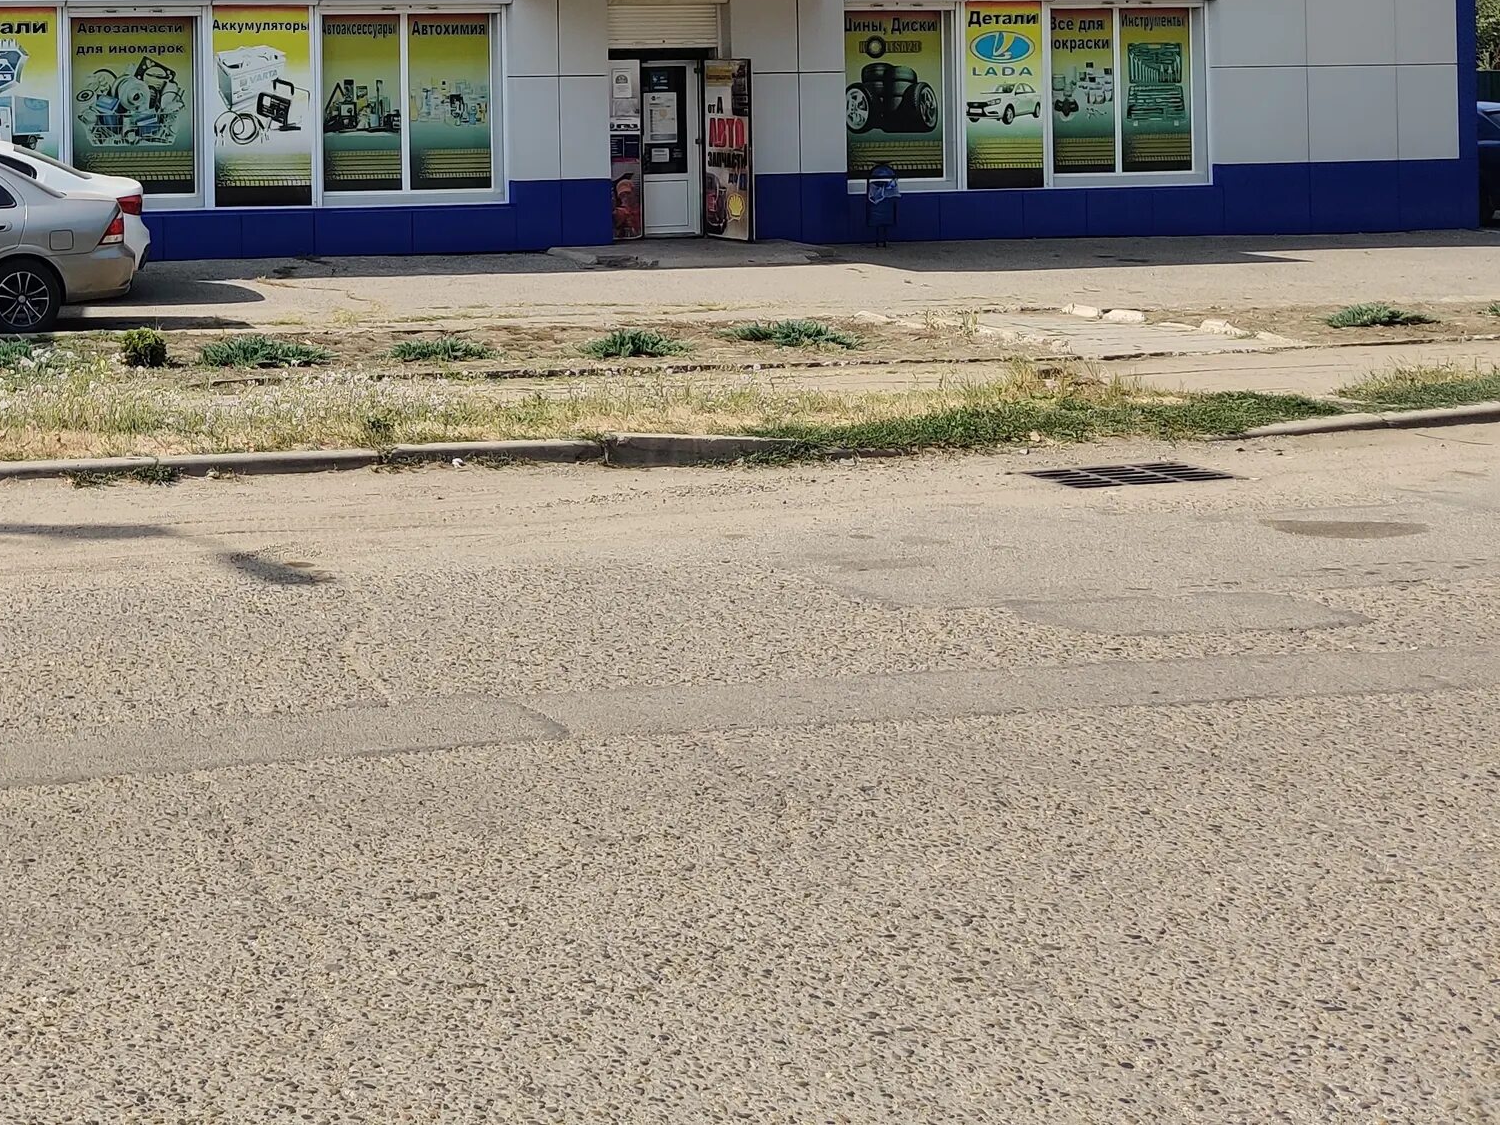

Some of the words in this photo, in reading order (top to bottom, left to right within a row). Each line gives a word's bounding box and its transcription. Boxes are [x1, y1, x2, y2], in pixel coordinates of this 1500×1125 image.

[213, 19, 310, 34] Аккумуляторы
[891, 17, 938, 35] Диски
[968, 11, 1038, 28] Детали
[1078, 19, 1104, 33] для
[1121, 14, 1184, 32] Инструменты
[77, 22, 184, 34] Автозапчасти
[322, 21, 396, 38] Автоаксессуары
[412, 21, 486, 36] Автохимия
[76, 44, 103, 56] для
[109, 44, 184, 56] иномарок
[249, 69, 278, 84] VARTA
[972, 66, 1033, 77] LADA
[709, 117, 745, 148] АВТО
[707, 151, 748, 169] ЗАПЧАСТИ
